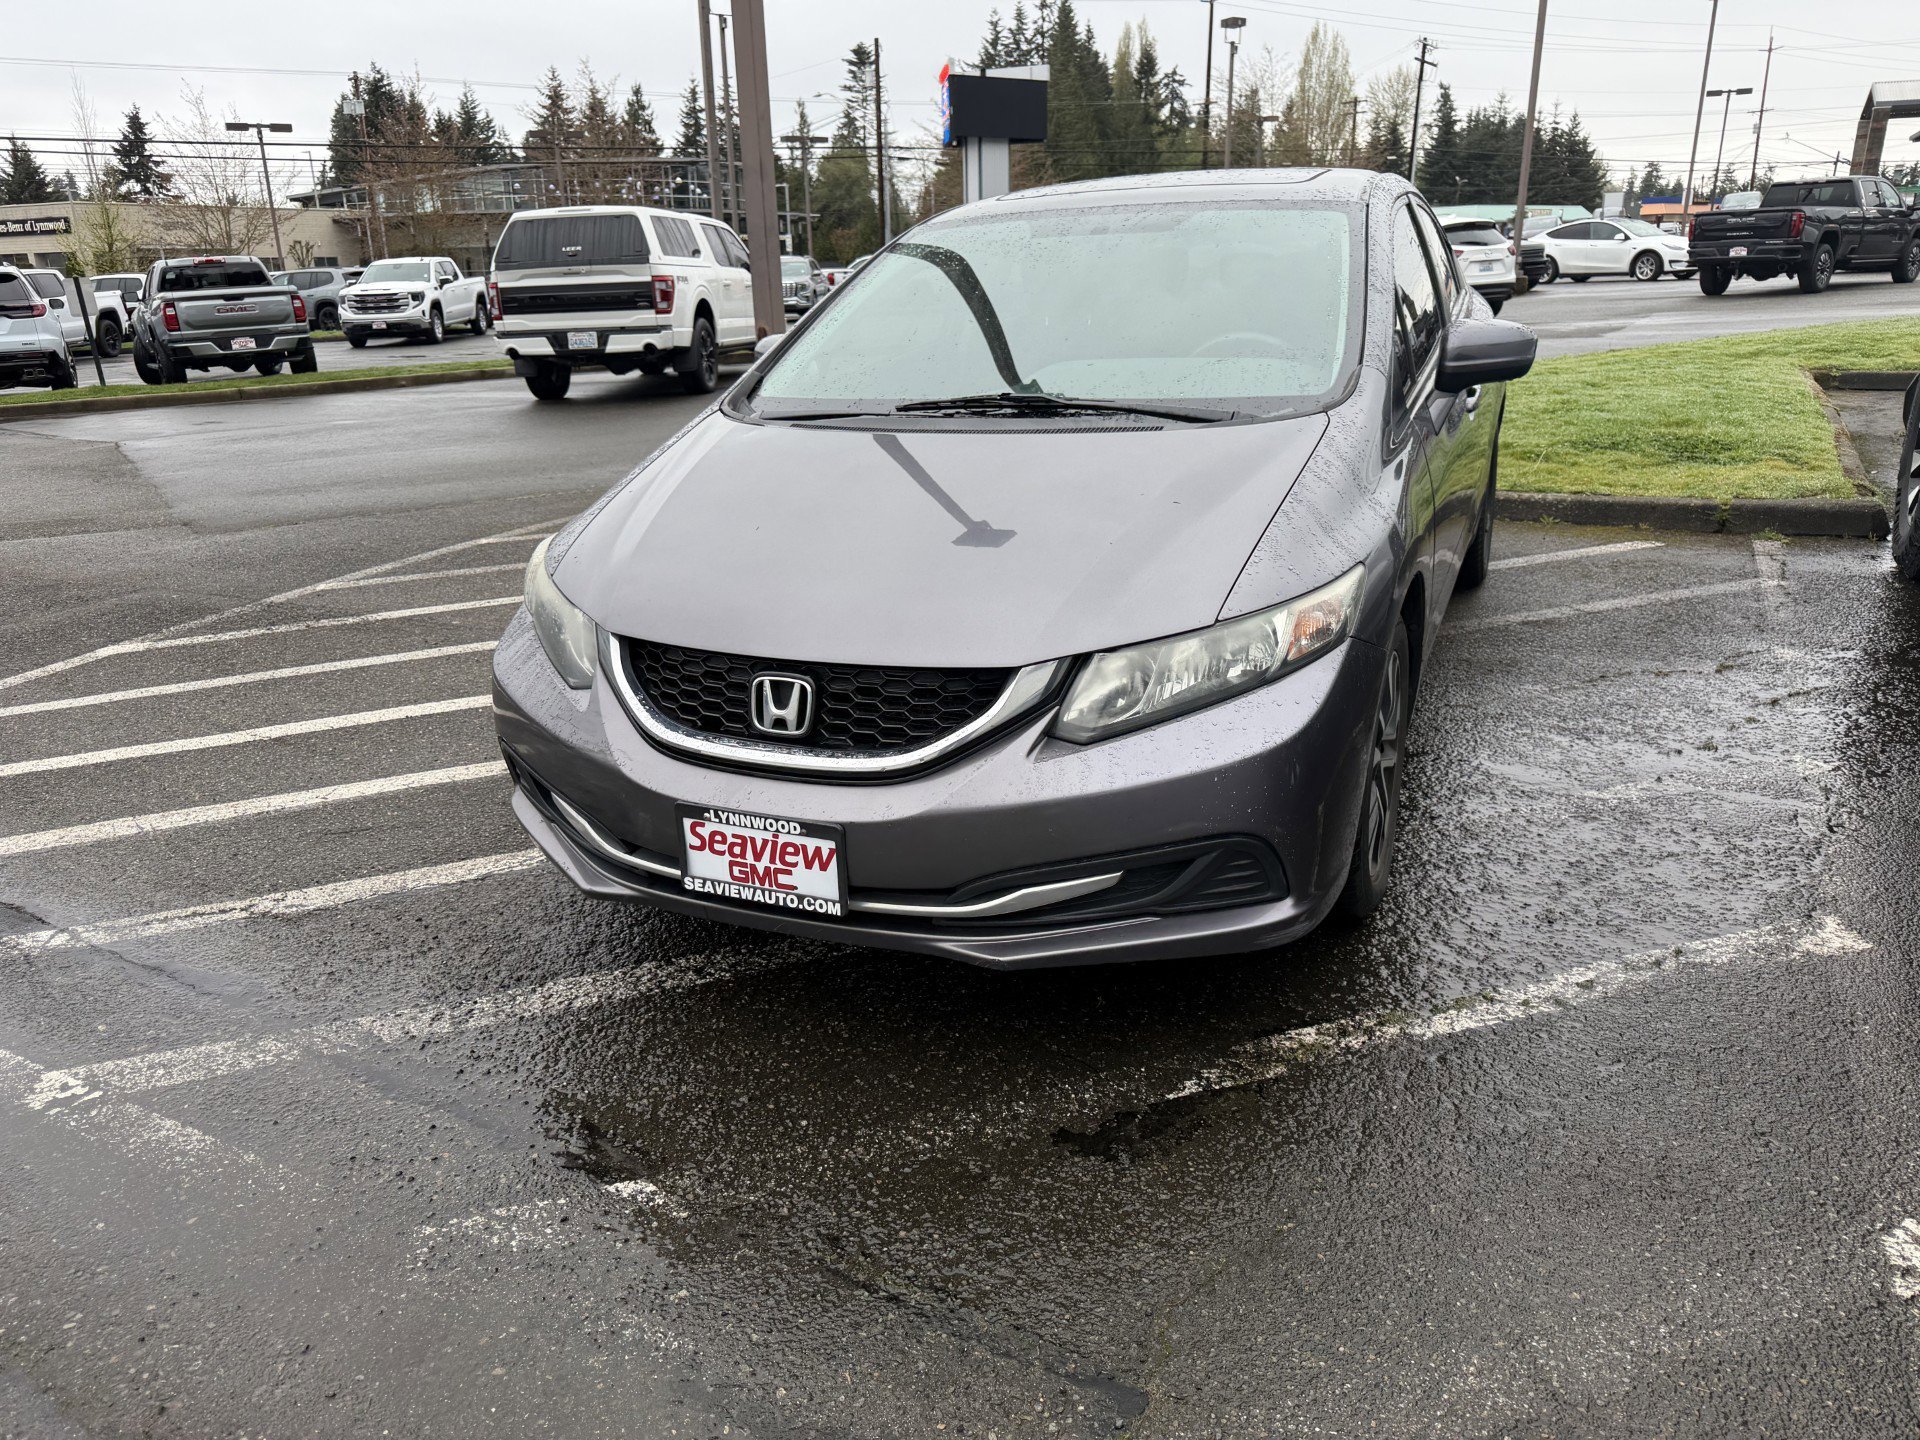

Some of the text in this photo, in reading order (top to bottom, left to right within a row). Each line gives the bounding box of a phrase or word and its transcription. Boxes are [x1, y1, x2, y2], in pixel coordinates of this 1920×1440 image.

[32, 219, 66, 234] Lynnwood
[215, 304, 258, 315] GMC
[709, 809, 801, 835] LYNNWOOD
[688, 820, 837, 872] Seaview
[728, 859, 798, 892] GMC
[683, 876, 842, 916] SEAVIEWAUTO.COM
